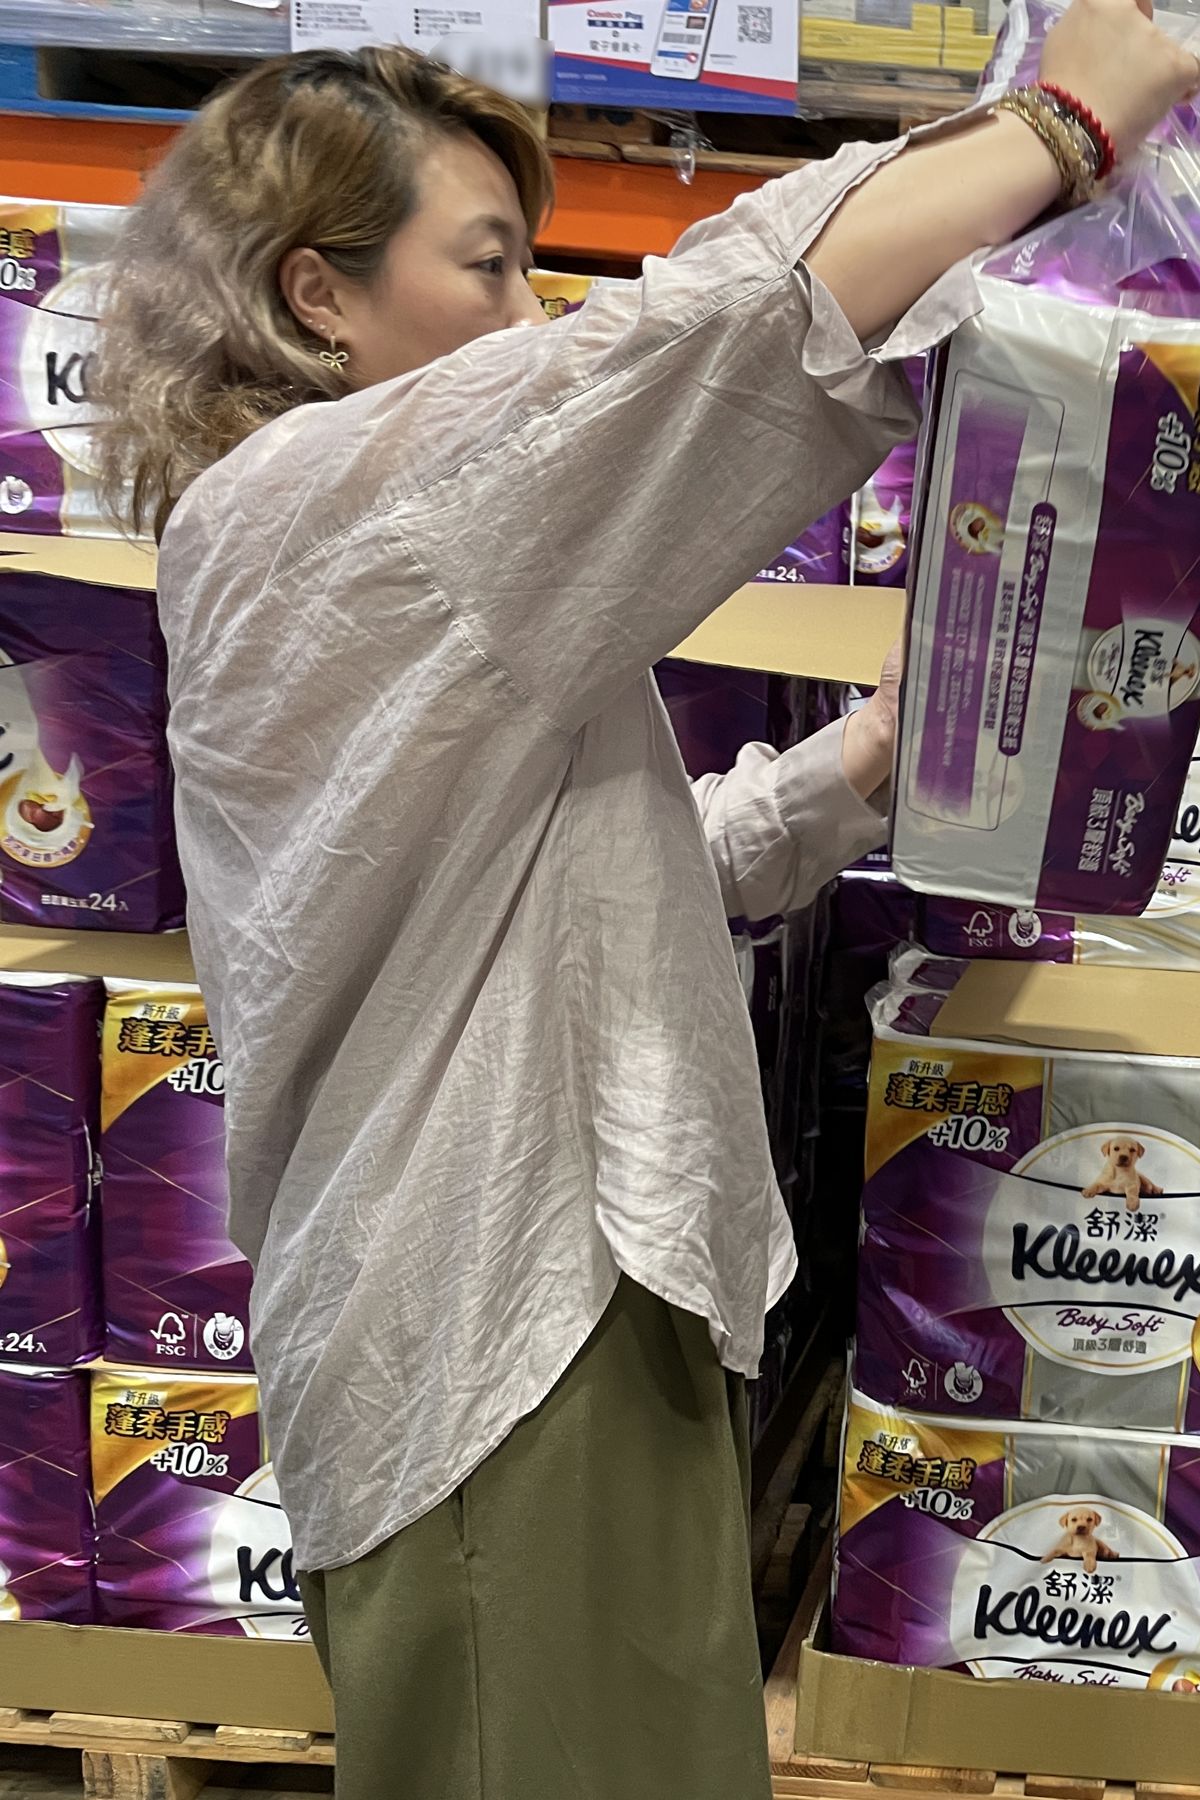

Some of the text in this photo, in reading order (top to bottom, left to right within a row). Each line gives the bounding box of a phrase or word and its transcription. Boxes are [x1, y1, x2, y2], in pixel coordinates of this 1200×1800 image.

[908, 1060, 944, 1077] 新升級
[885, 1076, 1011, 1115] 蓬柔手感
[928, 1115, 1009, 1152] +10%
[1084, 1207, 1158, 1243] 舒潔
[1056, 1308, 1165, 1336] Baby Soft
[155, 1343, 187, 1357] FSC
[1072, 1337, 1147, 1355] 頂級3層舒適
[125, 1389, 160, 1407] 新升級
[105, 1404, 231, 1444] 蓬柔手感
[150, 1443, 229, 1478] +10%
[857, 1441, 977, 1492] 蓬柔手感
[899, 1487, 974, 1521] +10%
[1042, 1569, 1114, 1605] 舒潔
[973, 1583, 1177, 1659] Kleenex
